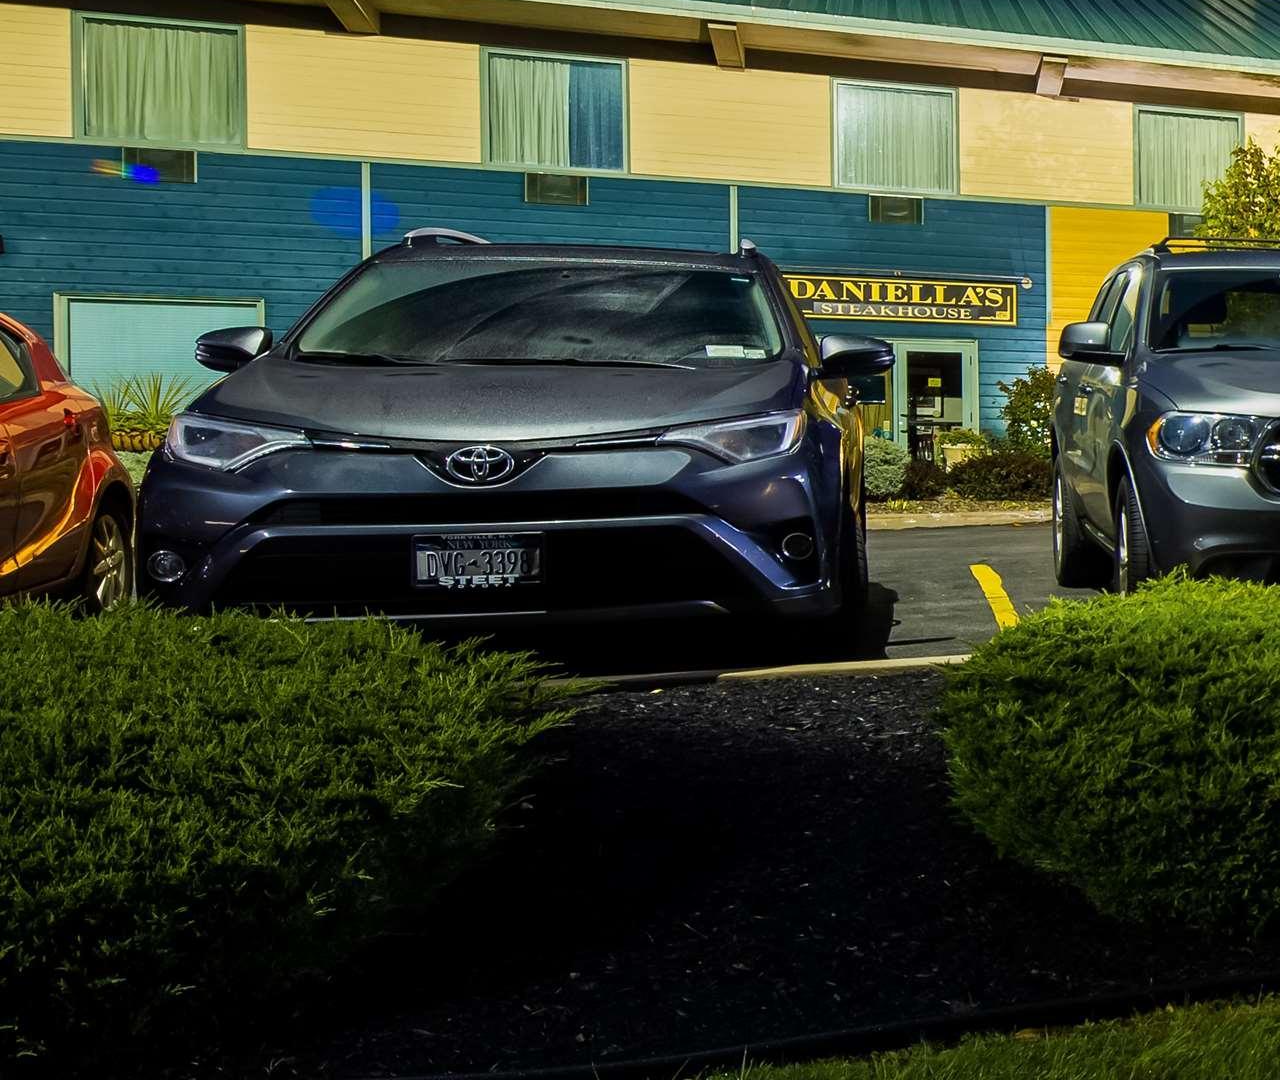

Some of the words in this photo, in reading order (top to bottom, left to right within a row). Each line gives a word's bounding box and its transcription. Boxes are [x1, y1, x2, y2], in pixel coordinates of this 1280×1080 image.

[788, 279, 1003, 307] DANIELLA'S
[821, 301, 972, 320] STEAKHOUSE
[447, 541, 473, 549] NEW
[480, 540, 512, 548] YORK
[439, 574, 519, 585] STEET
